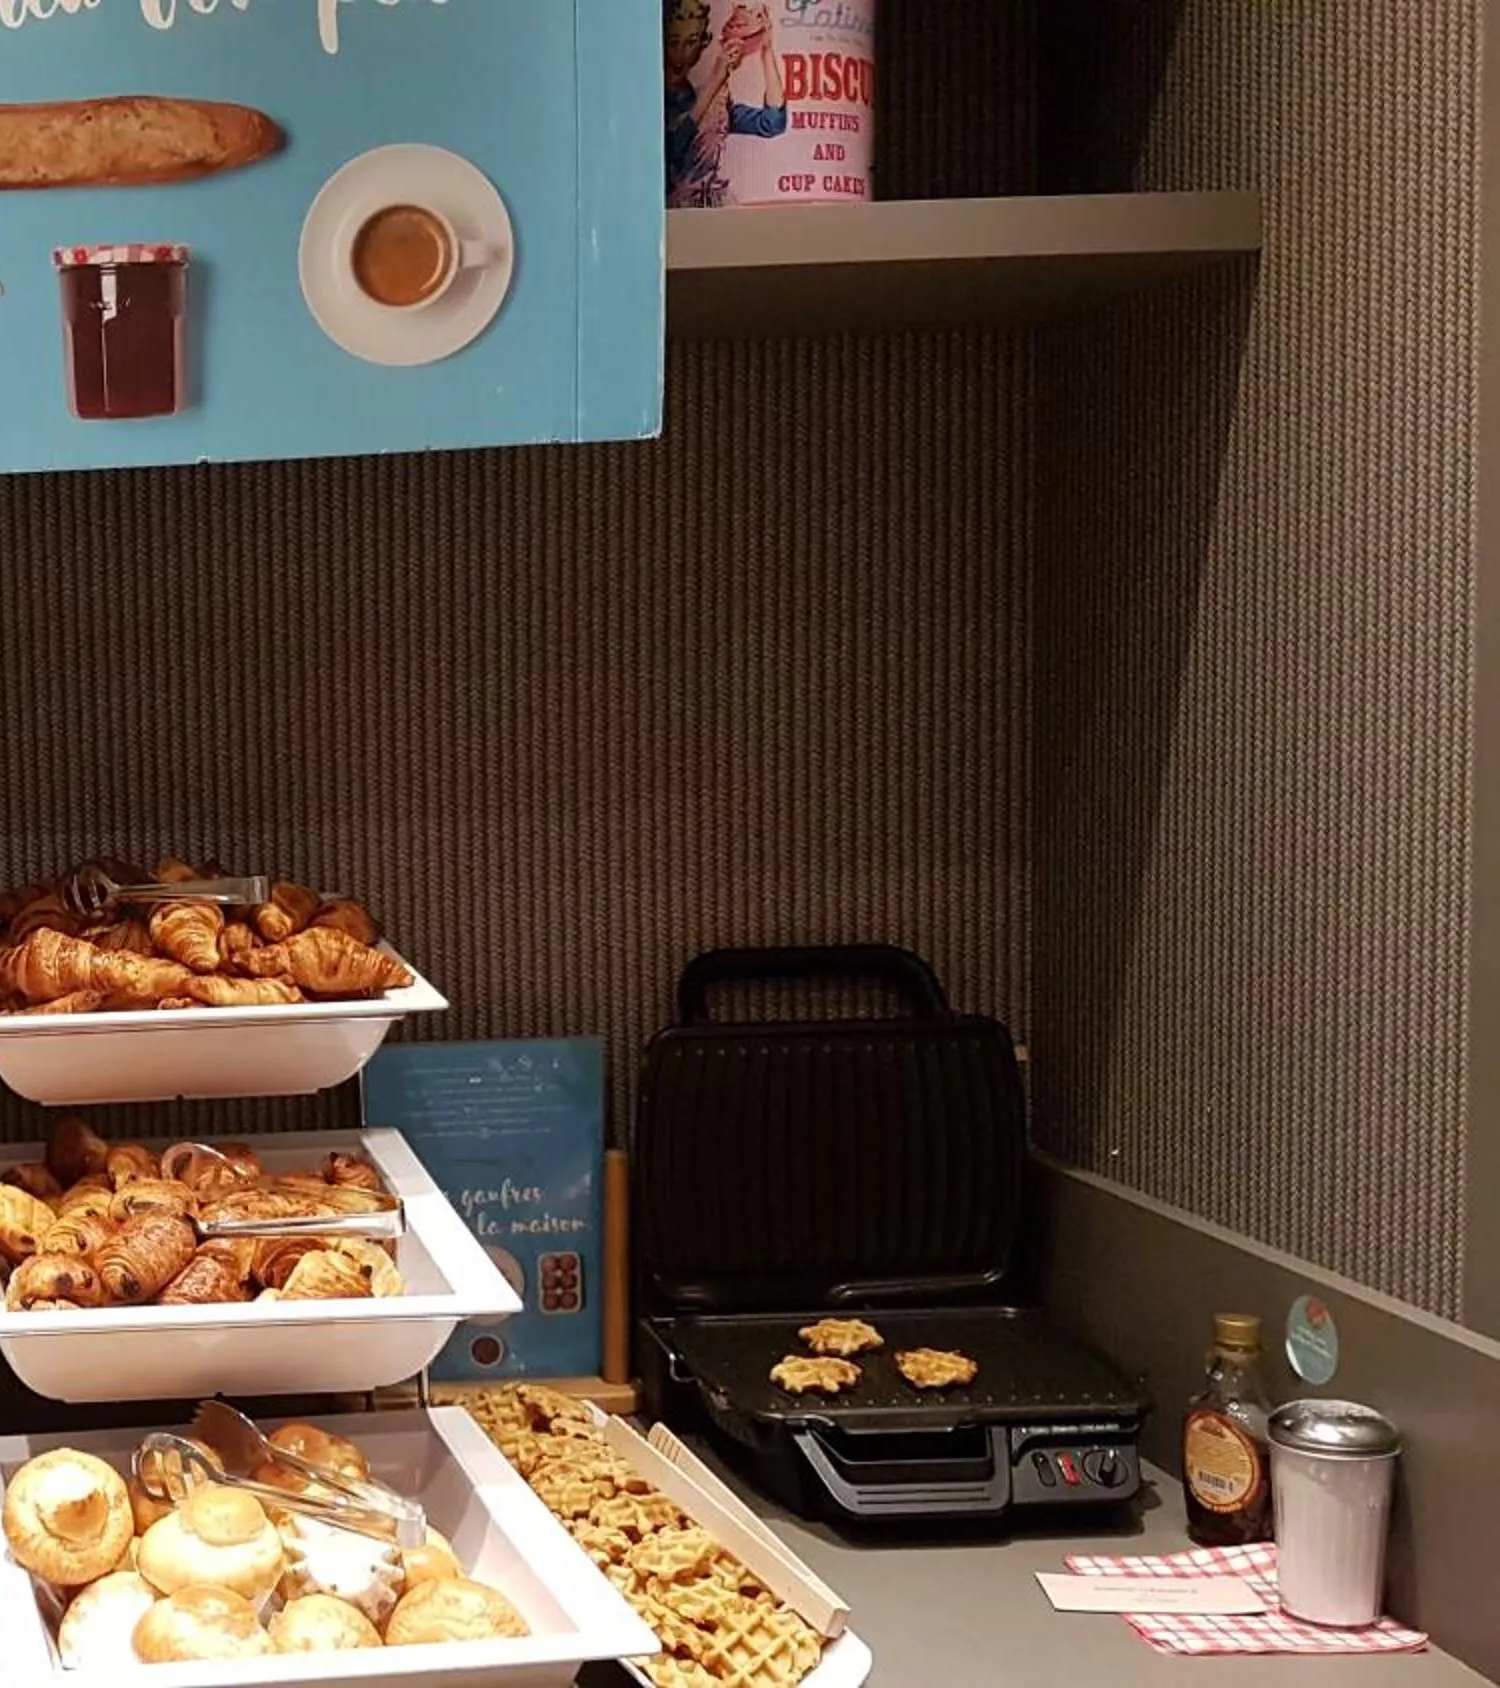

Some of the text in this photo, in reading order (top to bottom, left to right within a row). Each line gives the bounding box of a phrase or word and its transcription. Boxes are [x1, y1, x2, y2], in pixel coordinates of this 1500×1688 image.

[791, 111, 861, 132] MUFFINS
[812, 143, 847, 161] AND
[778, 174, 867, 195] CUP CAKES
[460, 1177, 544, 1218] gaufres
[476, 1210, 586, 1237] la maison
